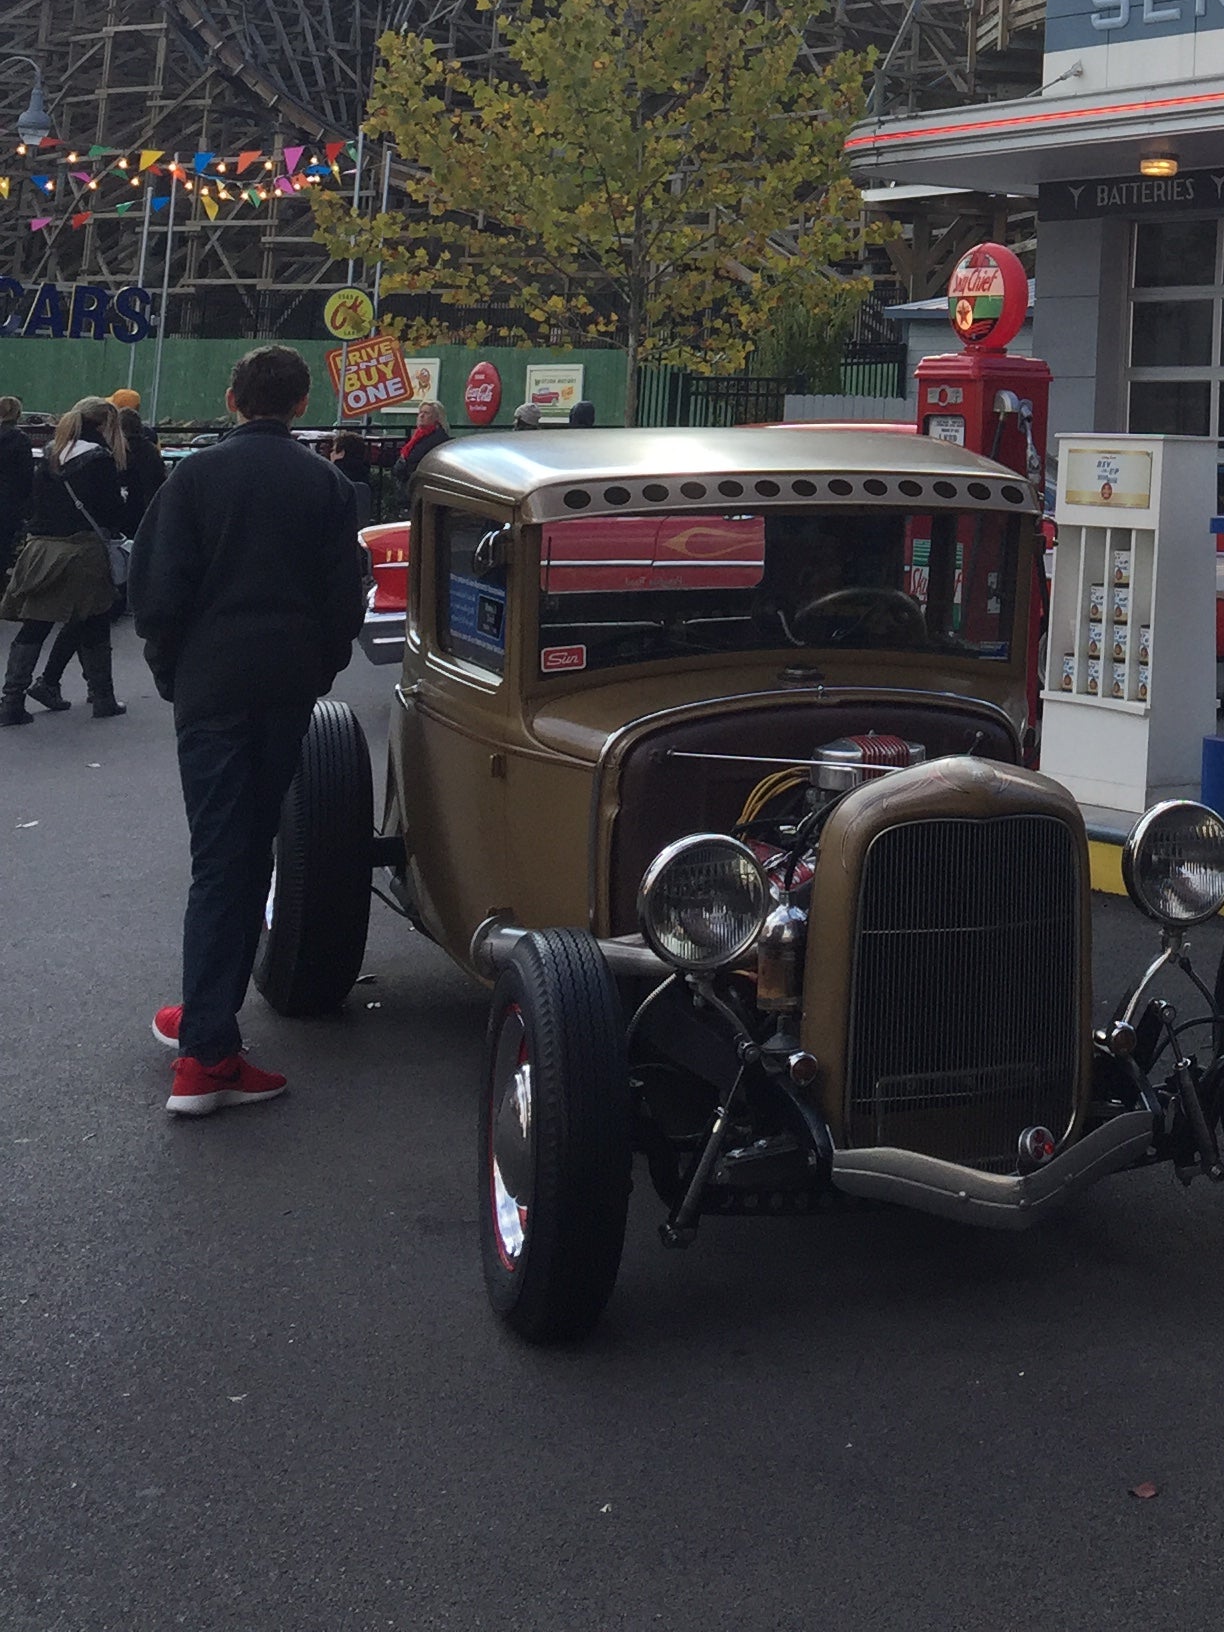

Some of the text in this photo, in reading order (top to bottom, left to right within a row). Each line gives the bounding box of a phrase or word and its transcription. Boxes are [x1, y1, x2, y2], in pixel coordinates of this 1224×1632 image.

[1096, 178, 1196, 206] BATTERIES
[967, 267, 999, 292] Chief
[344, 359, 395, 393] BUY
[347, 377, 406, 409] ONE
[546, 651, 579, 666] Sun
